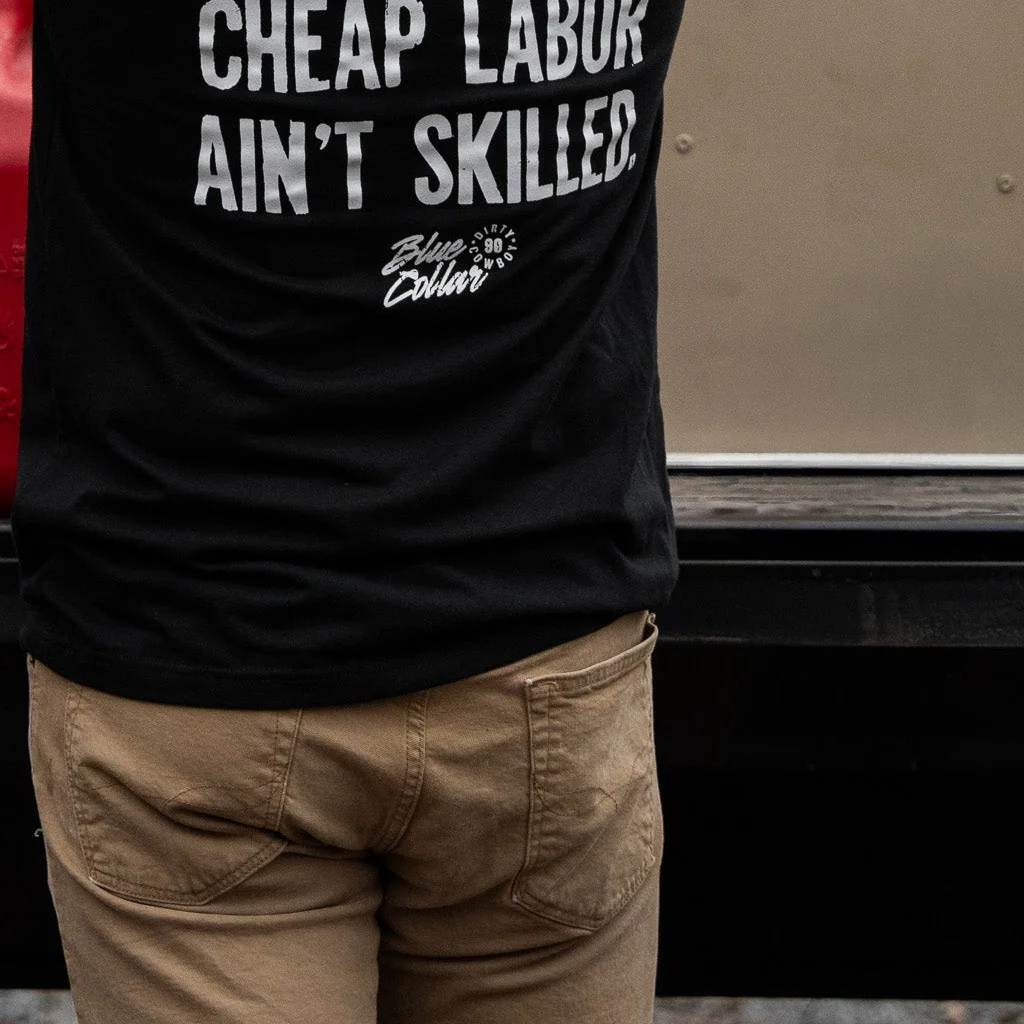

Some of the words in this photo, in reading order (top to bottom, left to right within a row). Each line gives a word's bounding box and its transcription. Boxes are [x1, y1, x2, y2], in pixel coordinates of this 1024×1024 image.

[193, 114, 374, 216] AIN'T
[413, 89, 637, 206] SKILLED.
[381, 232, 468, 277] Blue
[473, 223, 516, 241] DIRTY
[468, 244, 518, 270] COWBOY
[383, 260, 489, 308] Collar
